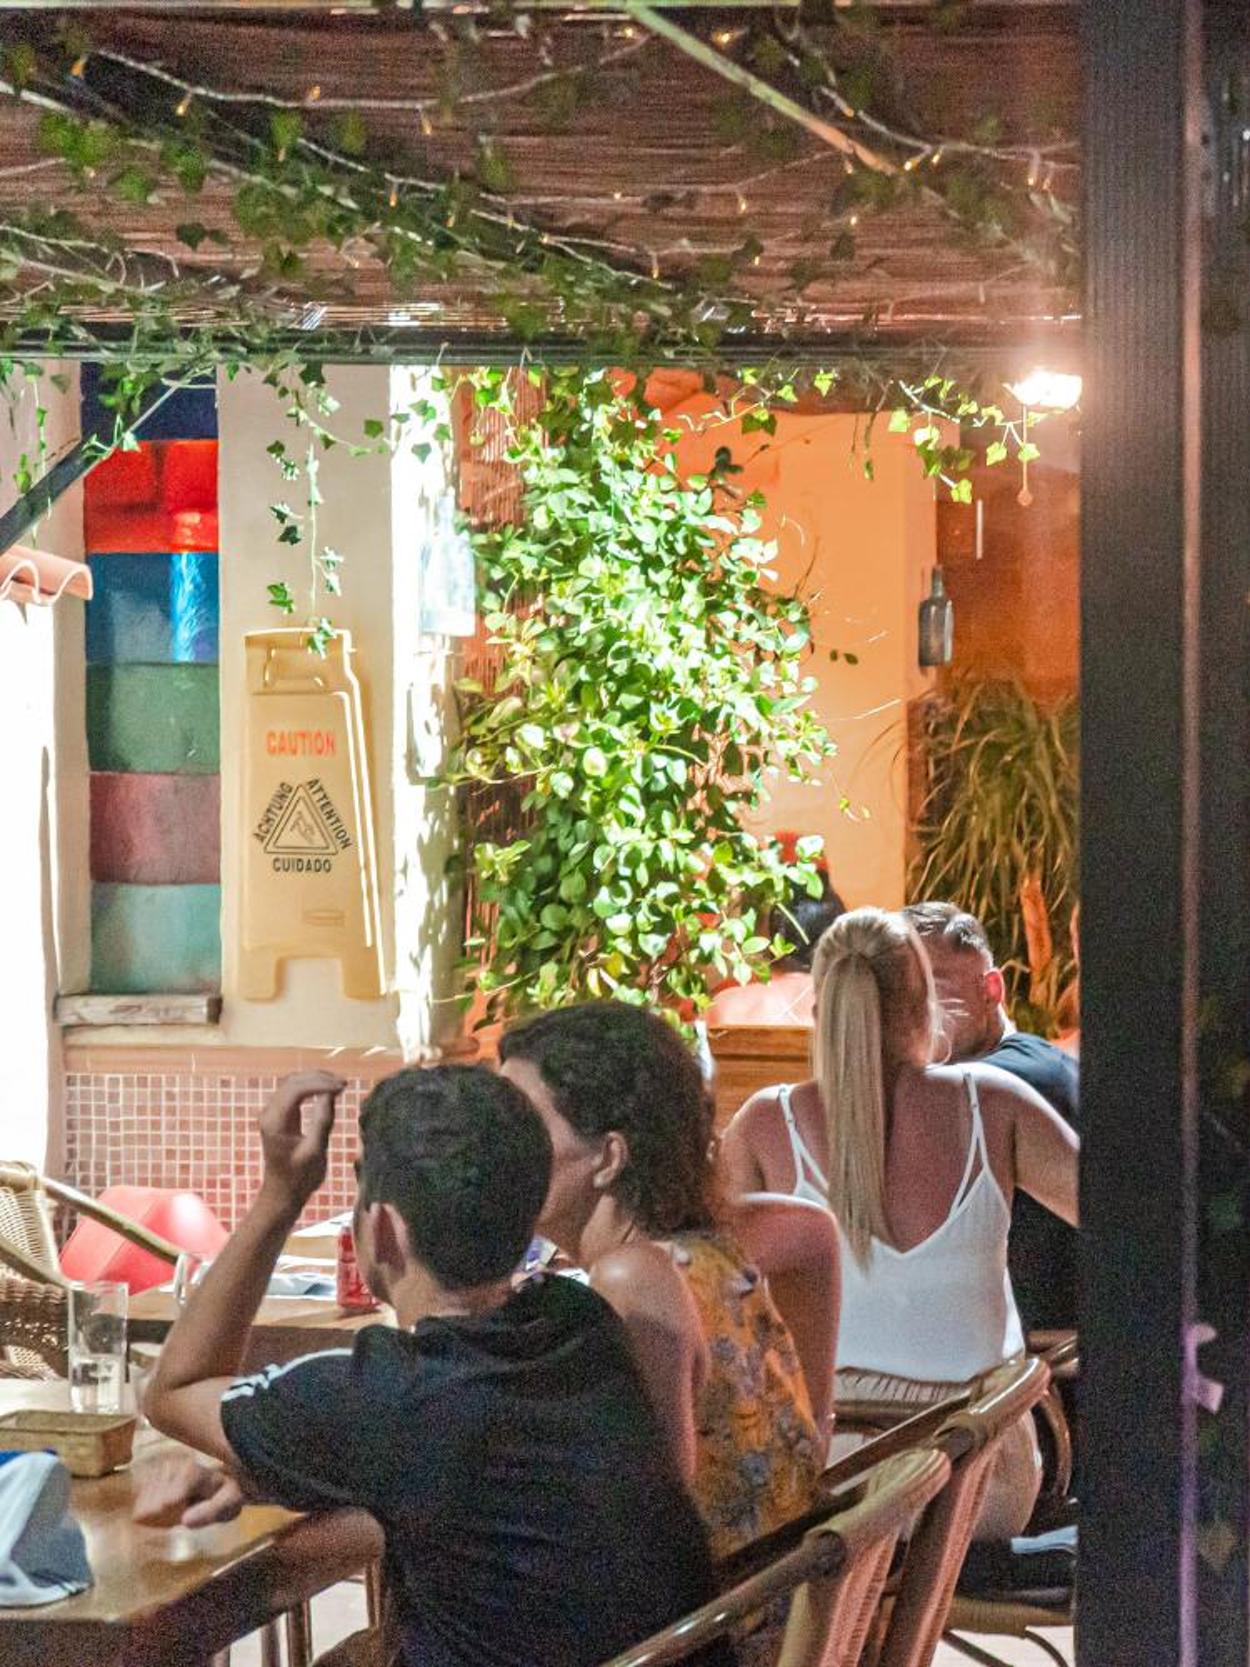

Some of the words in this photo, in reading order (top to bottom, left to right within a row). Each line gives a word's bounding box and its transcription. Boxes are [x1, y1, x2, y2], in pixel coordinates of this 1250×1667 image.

[266, 730, 336, 755] CAUTION
[252, 782, 293, 843] ACHTUNG
[307, 778, 353, 850] ATTENTION
[272, 857, 332, 873] CUIDADO
